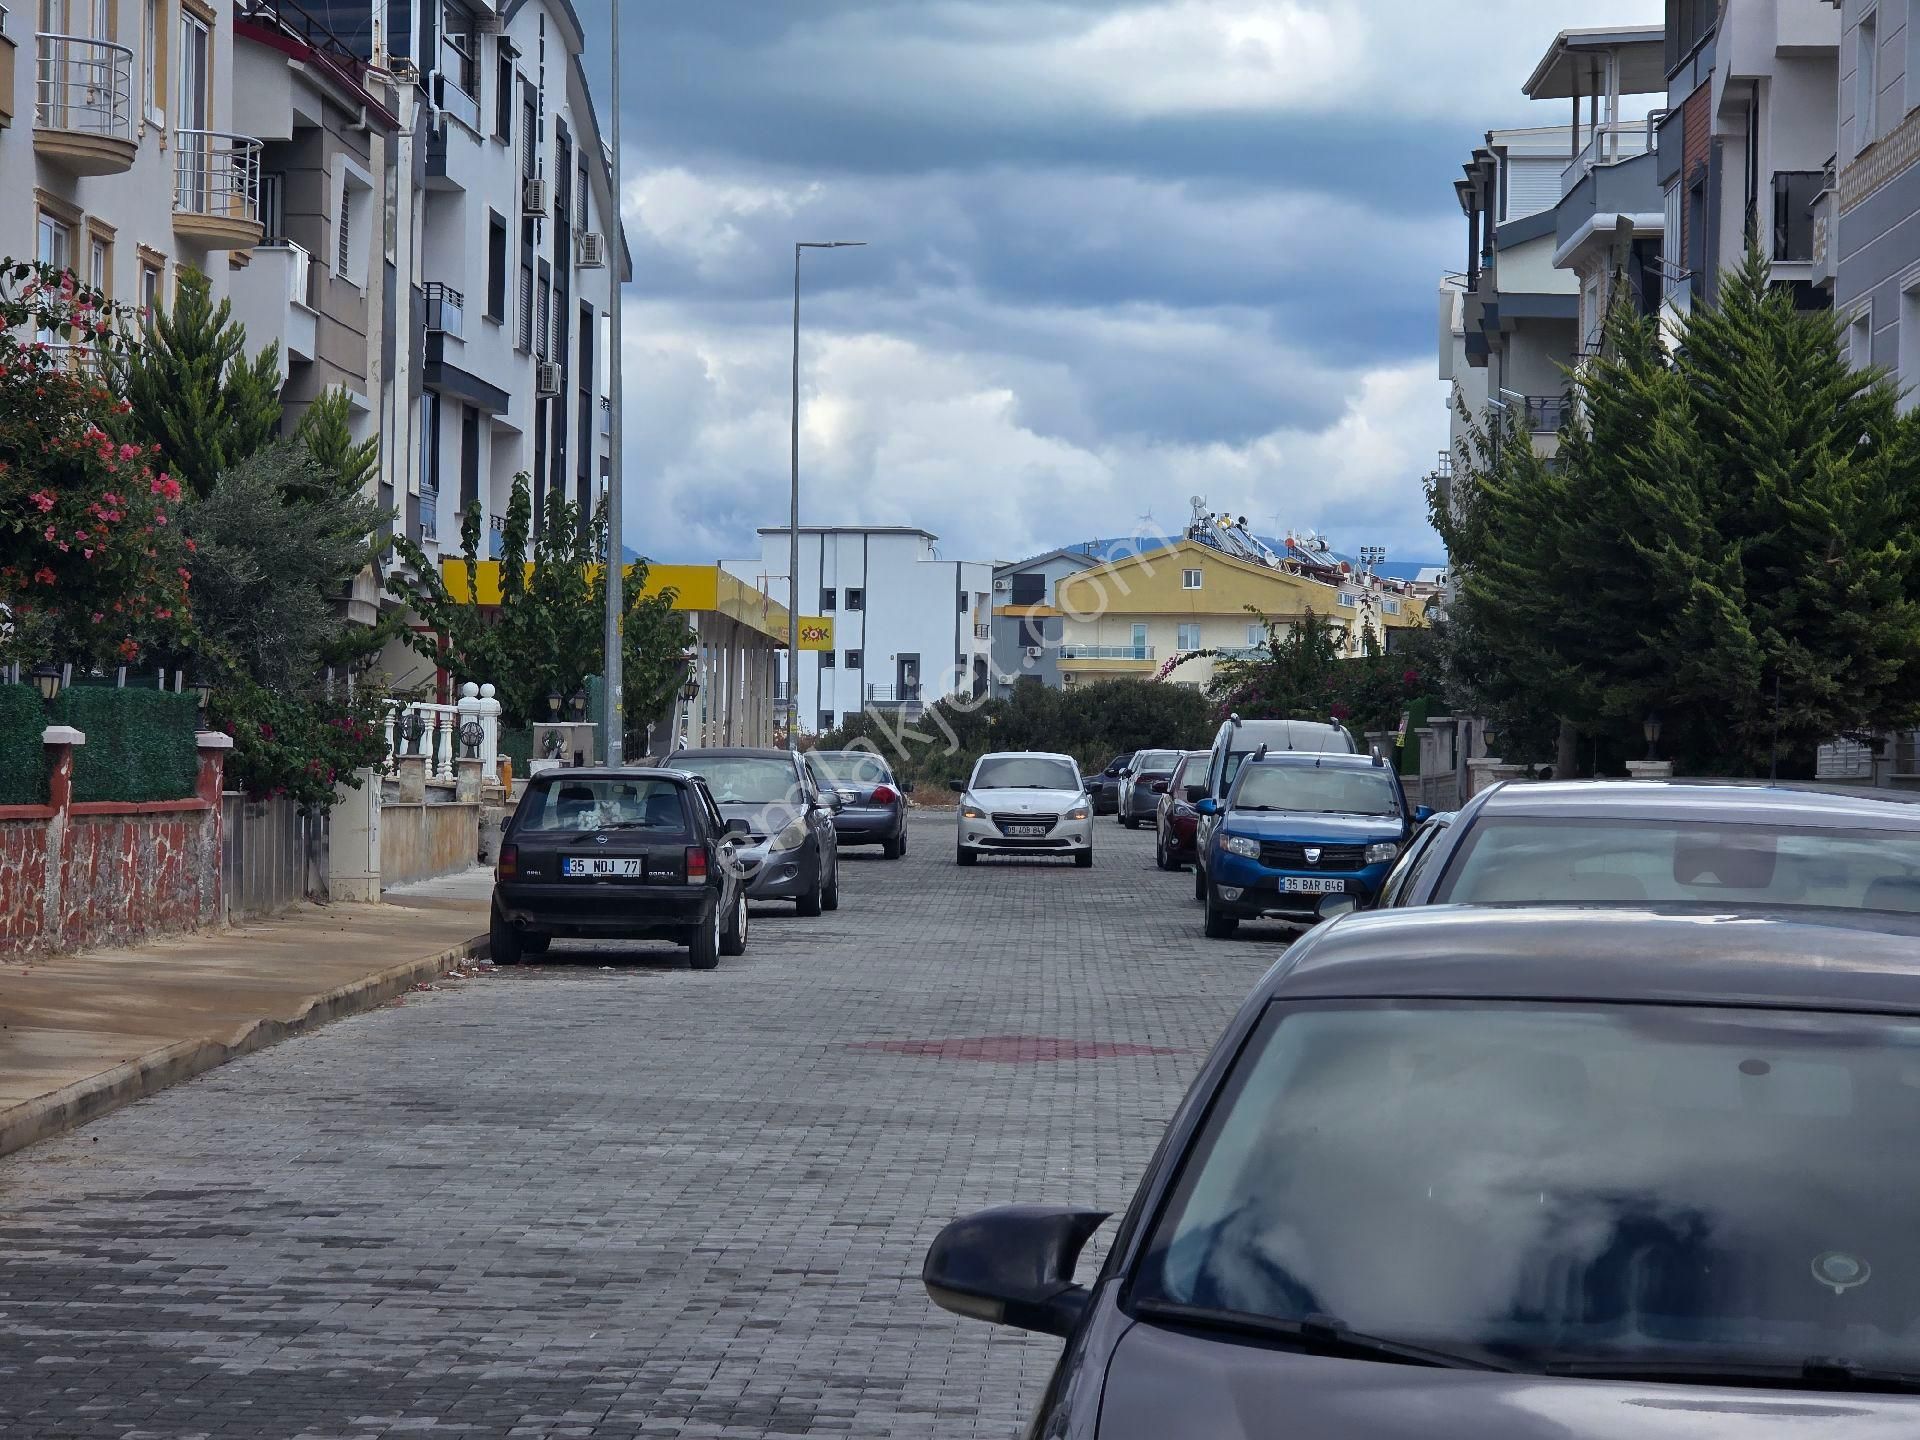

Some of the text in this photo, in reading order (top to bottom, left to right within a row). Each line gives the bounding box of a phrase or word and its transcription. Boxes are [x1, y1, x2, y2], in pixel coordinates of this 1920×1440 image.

[571, 860, 585, 873] 35
[594, 860, 615, 873] NDJ
[624, 860, 638, 874] 77
[1286, 878, 1343, 892] 35 BAR 846
